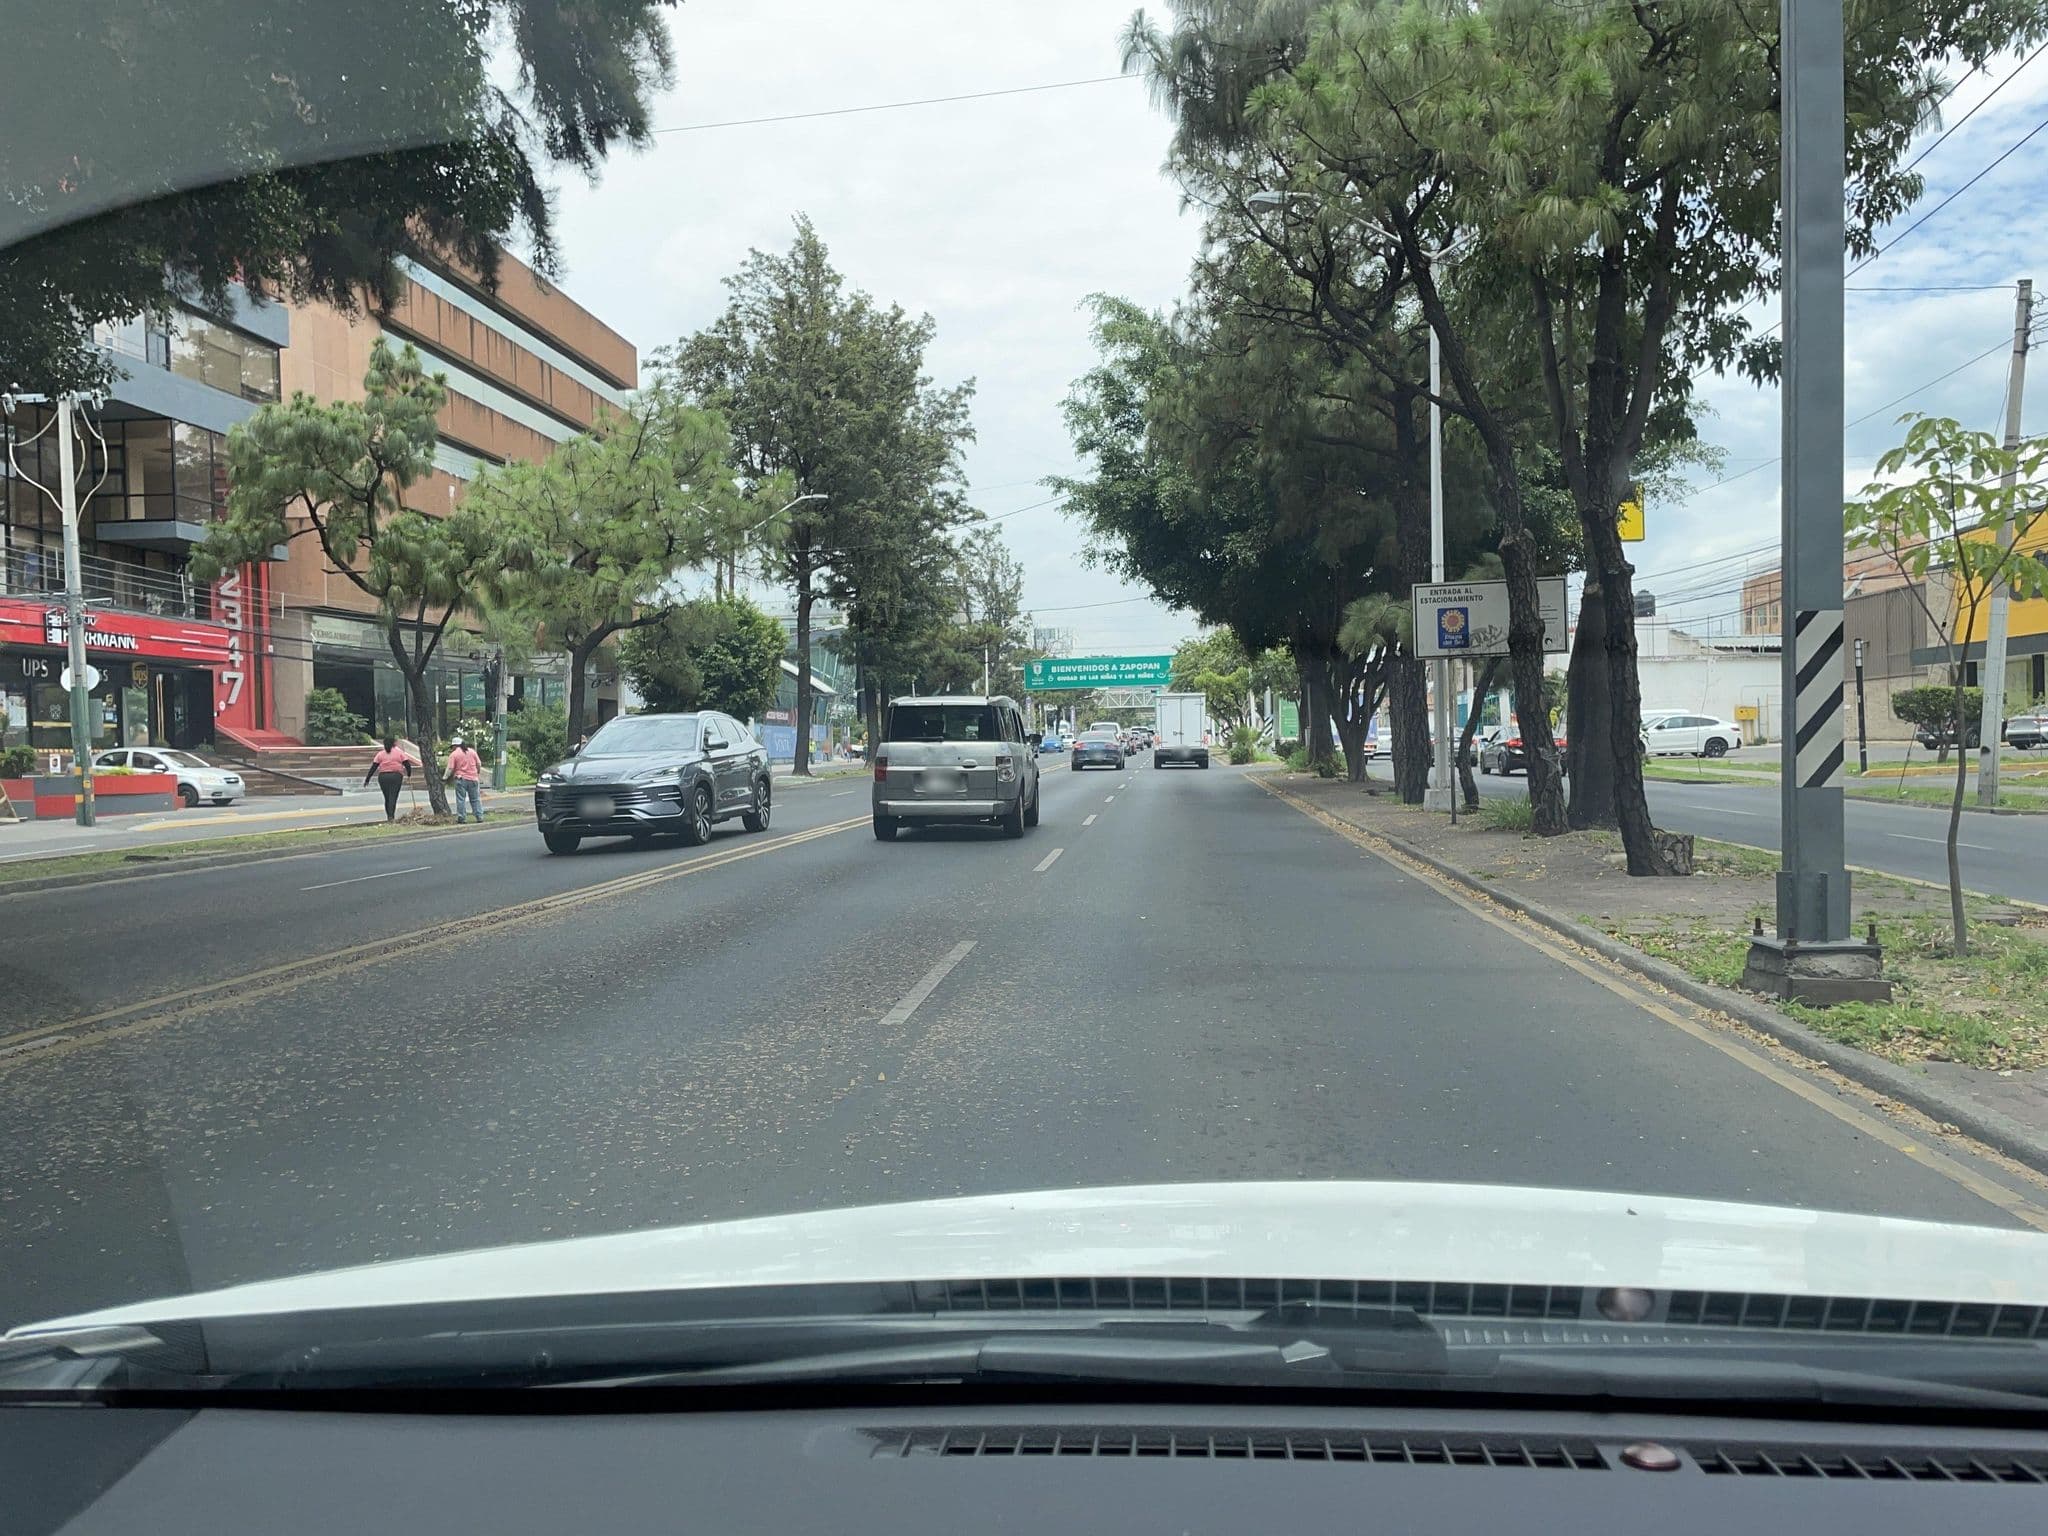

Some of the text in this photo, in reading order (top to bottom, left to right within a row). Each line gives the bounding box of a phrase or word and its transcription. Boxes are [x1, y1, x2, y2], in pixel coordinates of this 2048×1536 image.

[1420, 595, 1484, 604] ESTACIONAMIENTO
[63, 629, 136, 649] HRMANN
[22, 658, 49, 677] UPS
[1051, 665, 1110, 673] BIENVENIDOS
